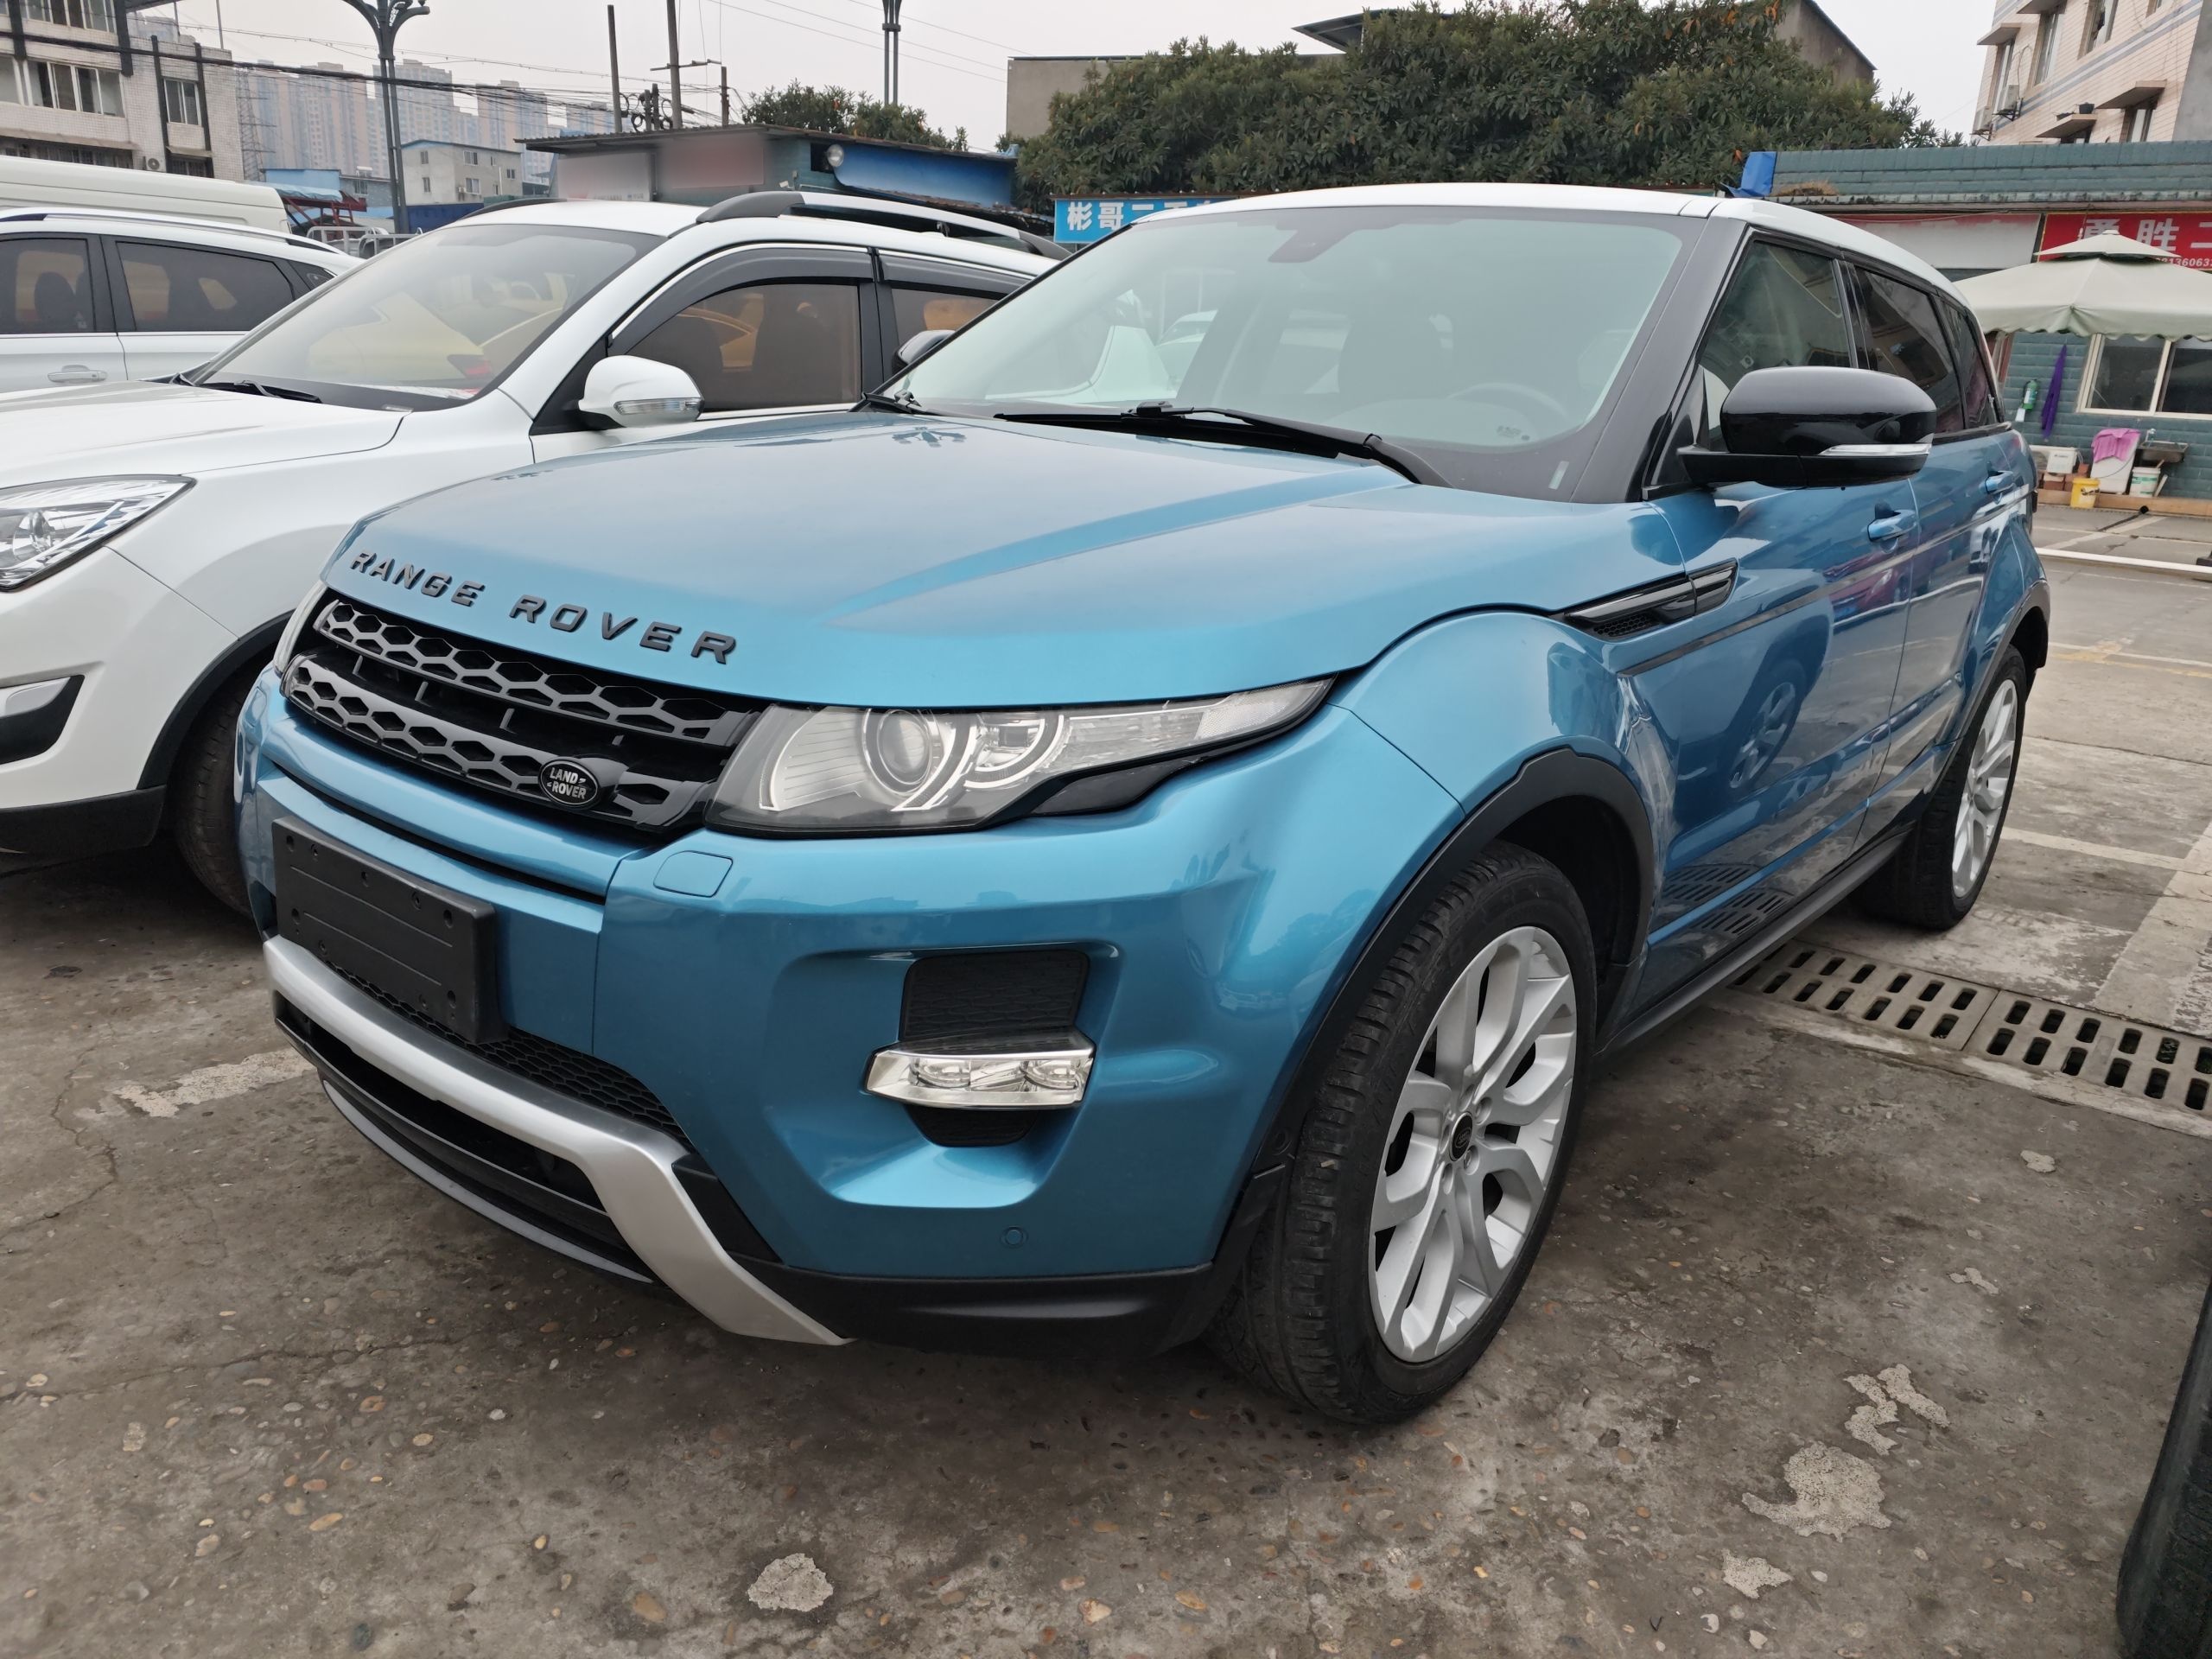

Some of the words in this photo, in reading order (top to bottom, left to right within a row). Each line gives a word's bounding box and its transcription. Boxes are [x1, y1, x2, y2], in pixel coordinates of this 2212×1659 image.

[350, 550, 485, 607] RANGE
[509, 594, 736, 664] ROVER
[550, 766, 579, 785] LAND
[551, 780, 587, 799] ROVER
